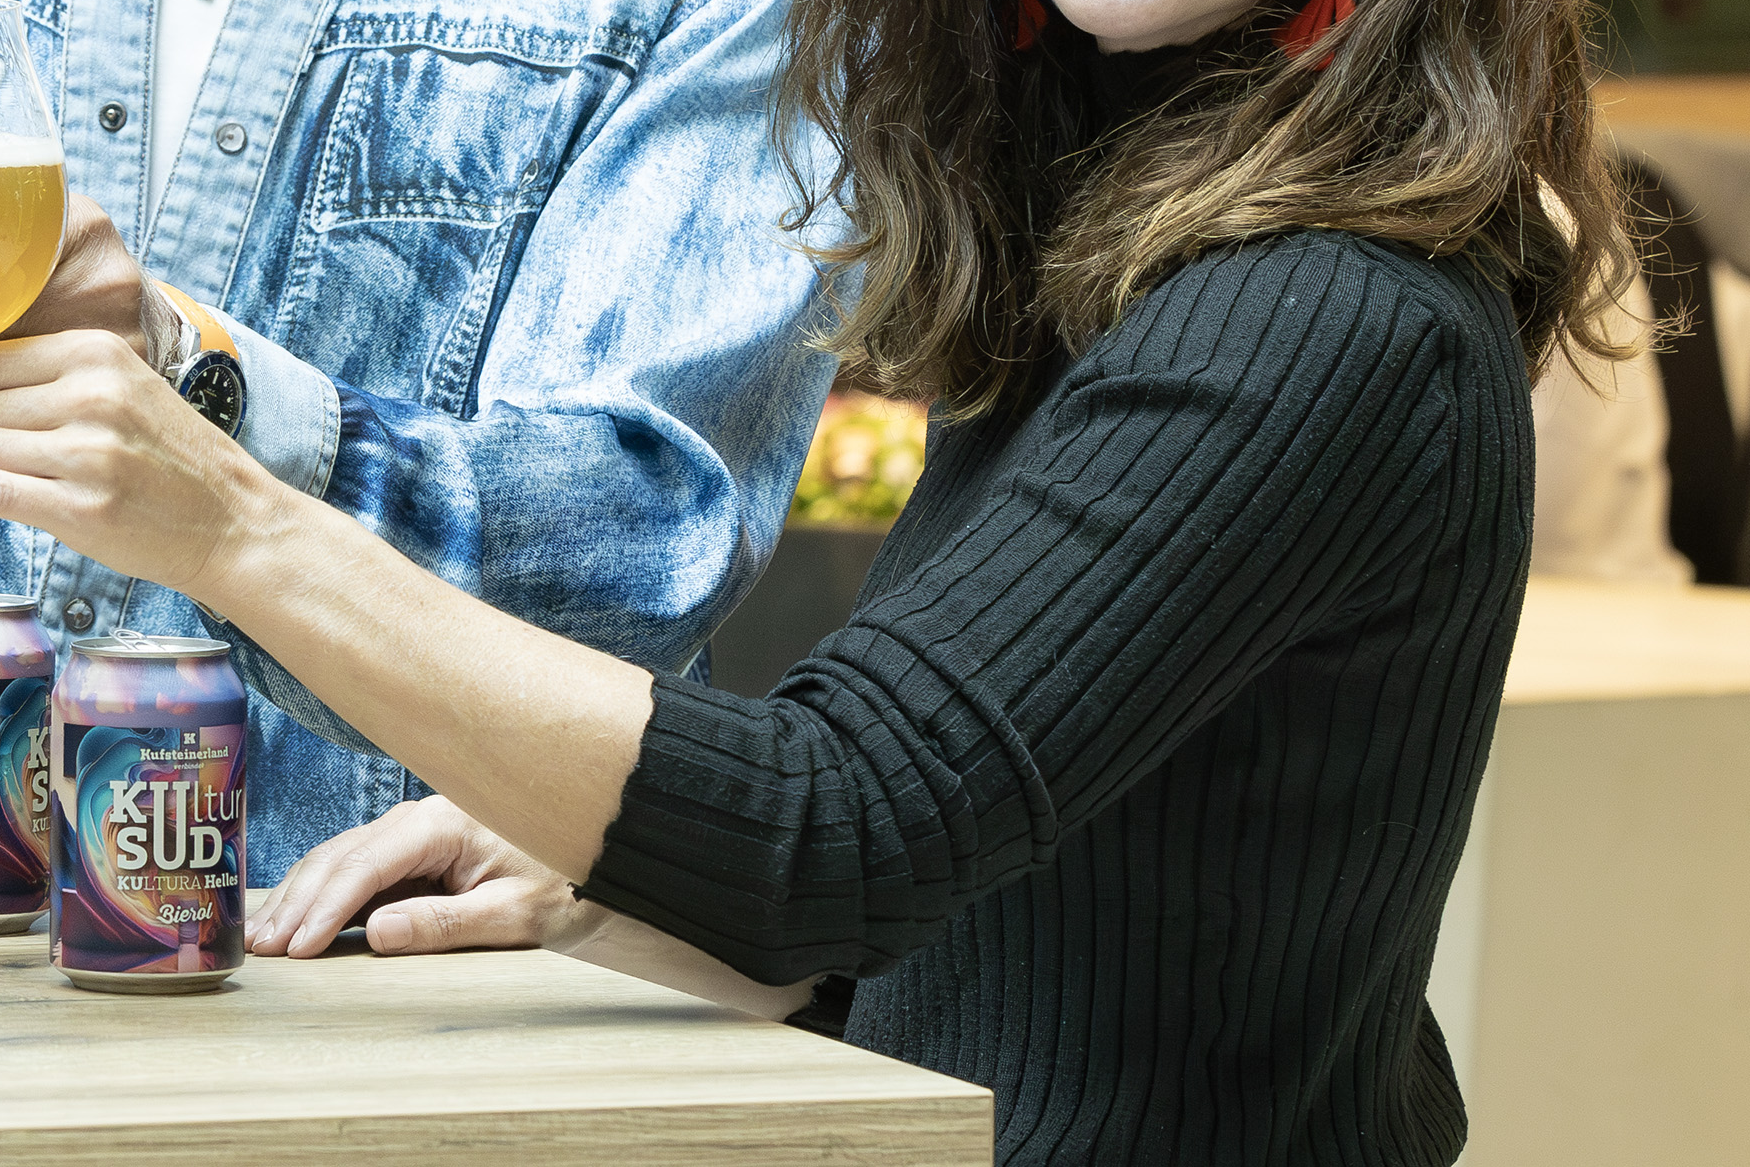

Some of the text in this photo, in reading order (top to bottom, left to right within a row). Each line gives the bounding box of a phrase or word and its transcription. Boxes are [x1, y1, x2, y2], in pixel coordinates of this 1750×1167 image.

[184, 733, 195, 744] K
[140, 746, 229, 762] Kufsteinerland
[116, 826, 223, 870] SUD
[117, 873, 238, 891] KULTURA Helles
[156, 902, 213, 924] Bierol
